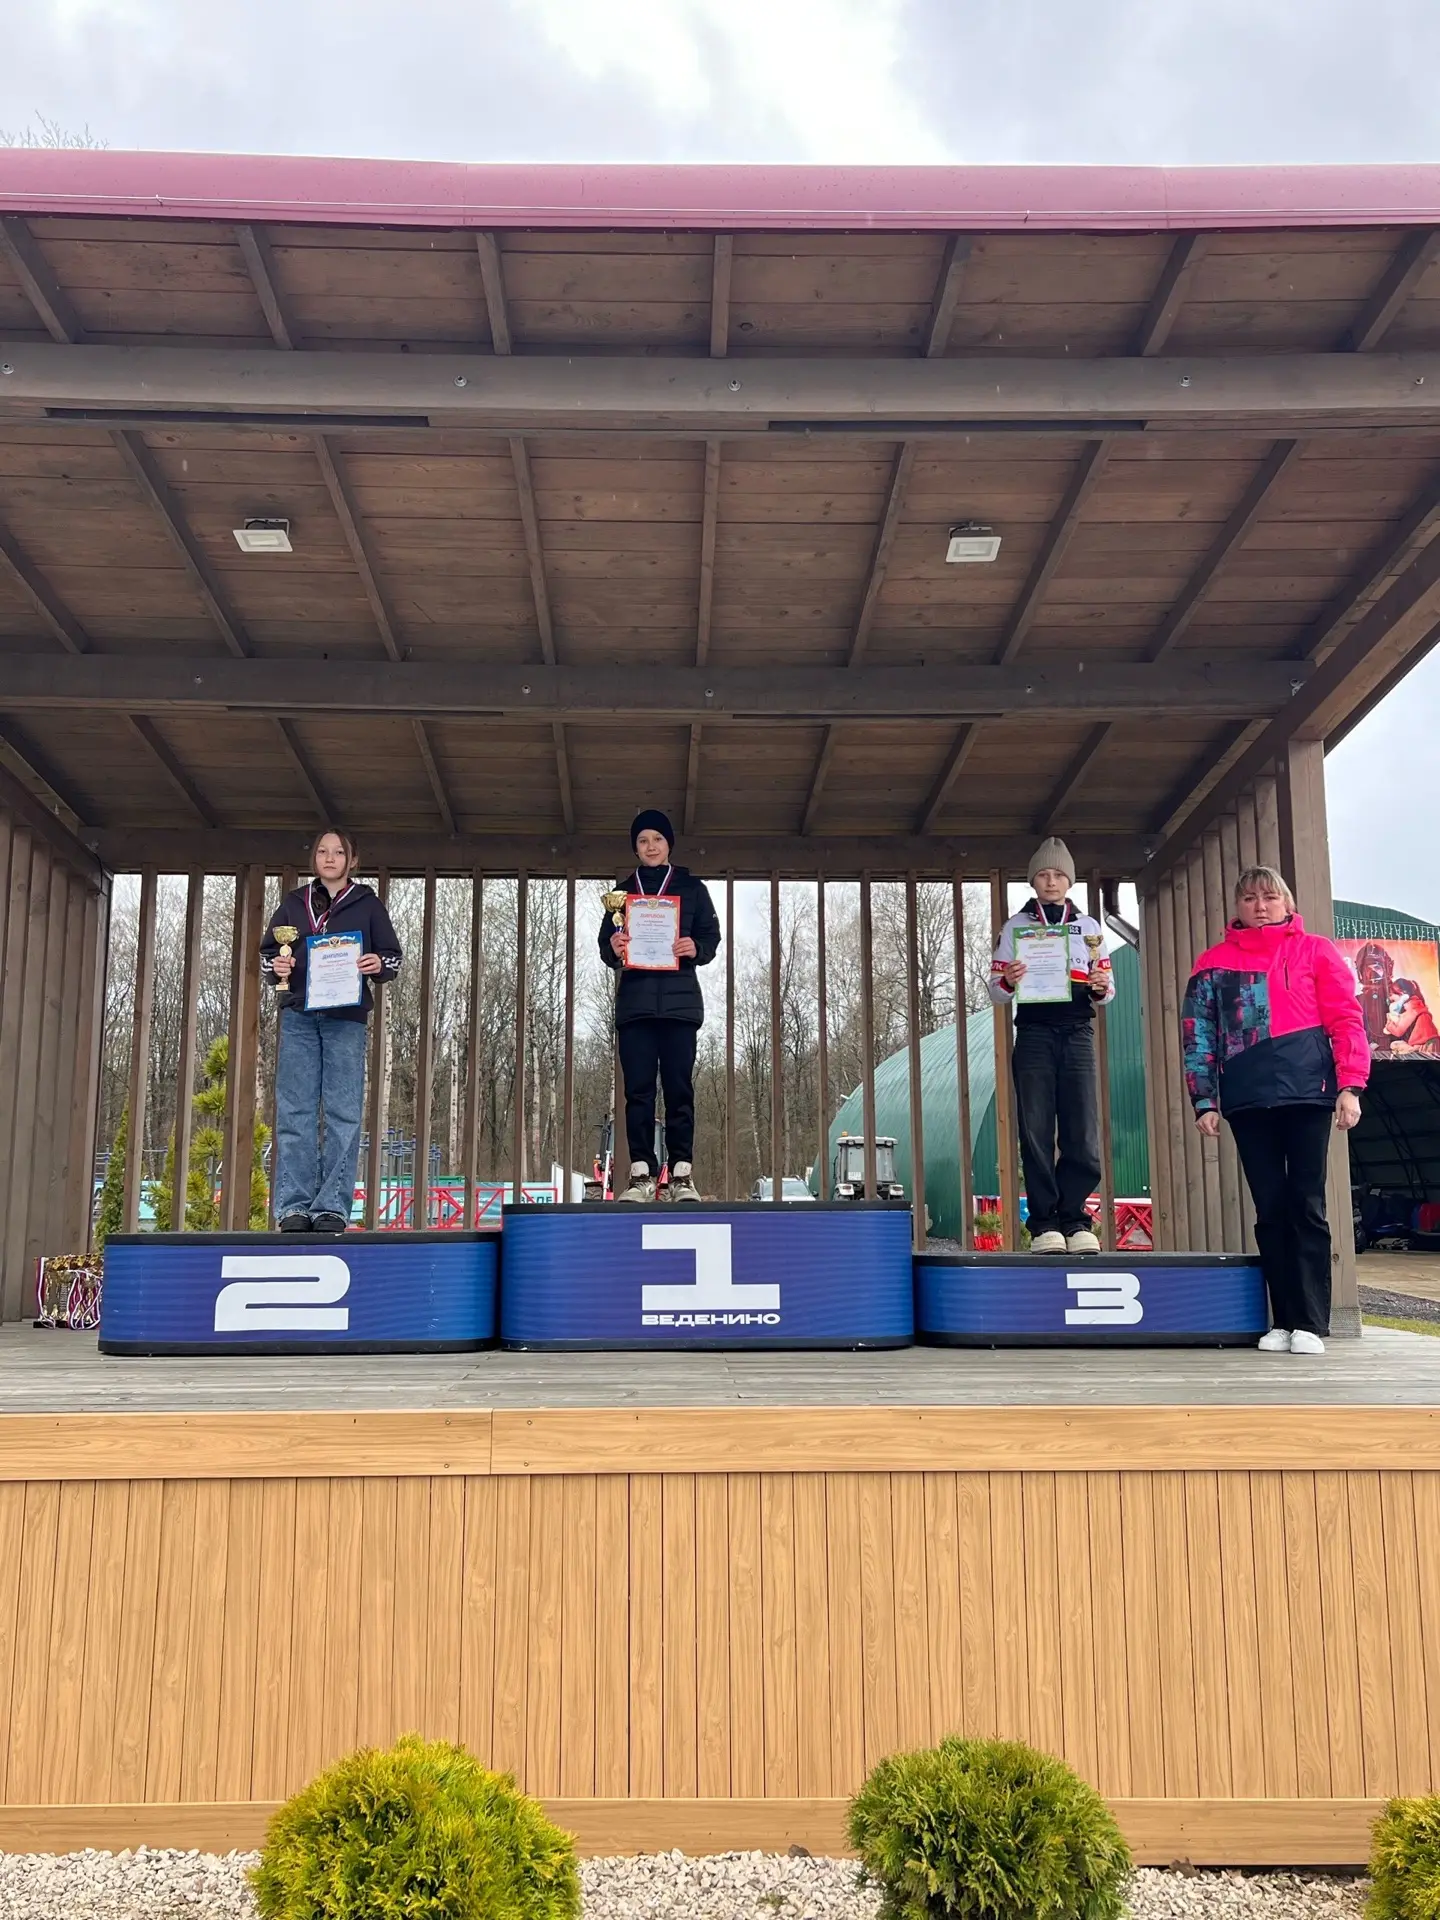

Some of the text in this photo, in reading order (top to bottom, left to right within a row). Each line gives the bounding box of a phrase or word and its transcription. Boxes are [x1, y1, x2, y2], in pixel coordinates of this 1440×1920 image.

[214, 1255, 350, 1332] 2
[642, 1223, 780, 1311] 1
[1065, 1273, 1143, 1324] 3
[642, 1313, 780, 1327] ВЕДЕНИНО
